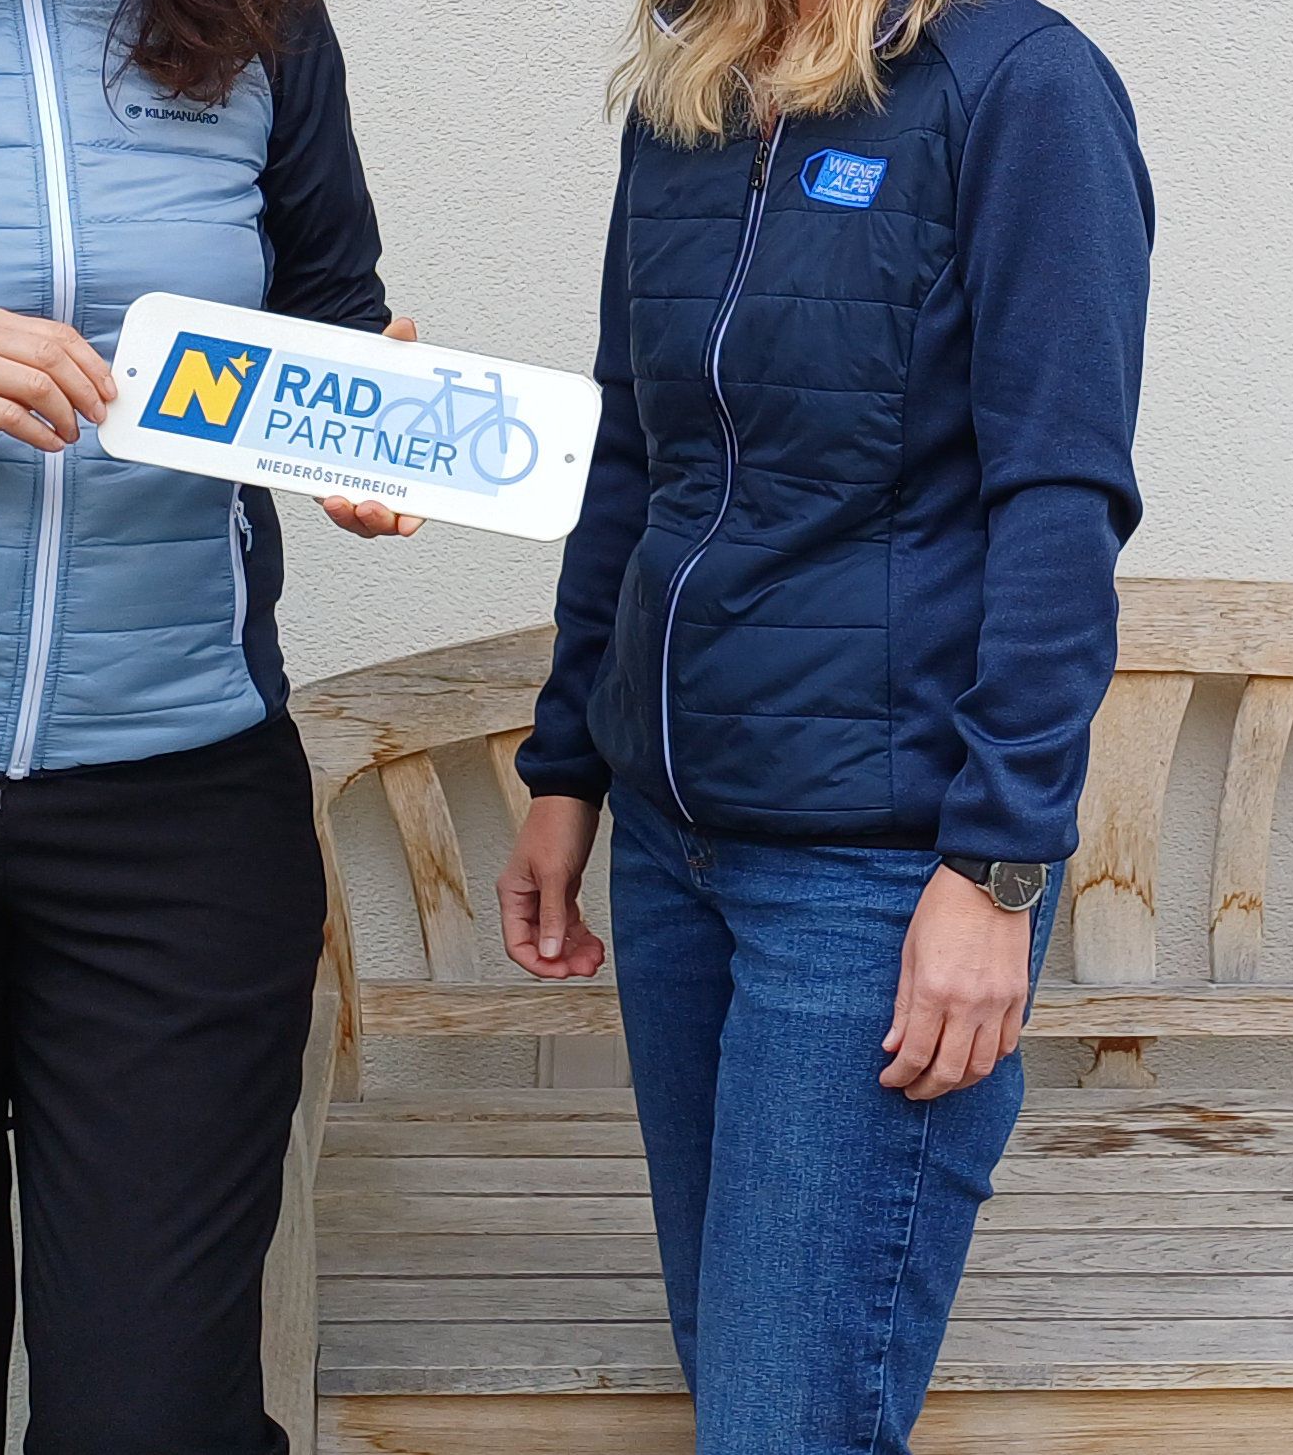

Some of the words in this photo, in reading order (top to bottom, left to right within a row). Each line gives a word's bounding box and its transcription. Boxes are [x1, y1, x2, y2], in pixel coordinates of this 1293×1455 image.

[145, 107, 219, 124] KILIMANJARO
[828, 175, 879, 194] ALPEN
[829, 156, 883, 179] WIENER
[157, 348, 243, 427] N
[273, 363, 383, 419] RAD
[264, 408, 457, 477] PARTNER
[256, 457, 409, 499] NIEDERÖSTERREICH
